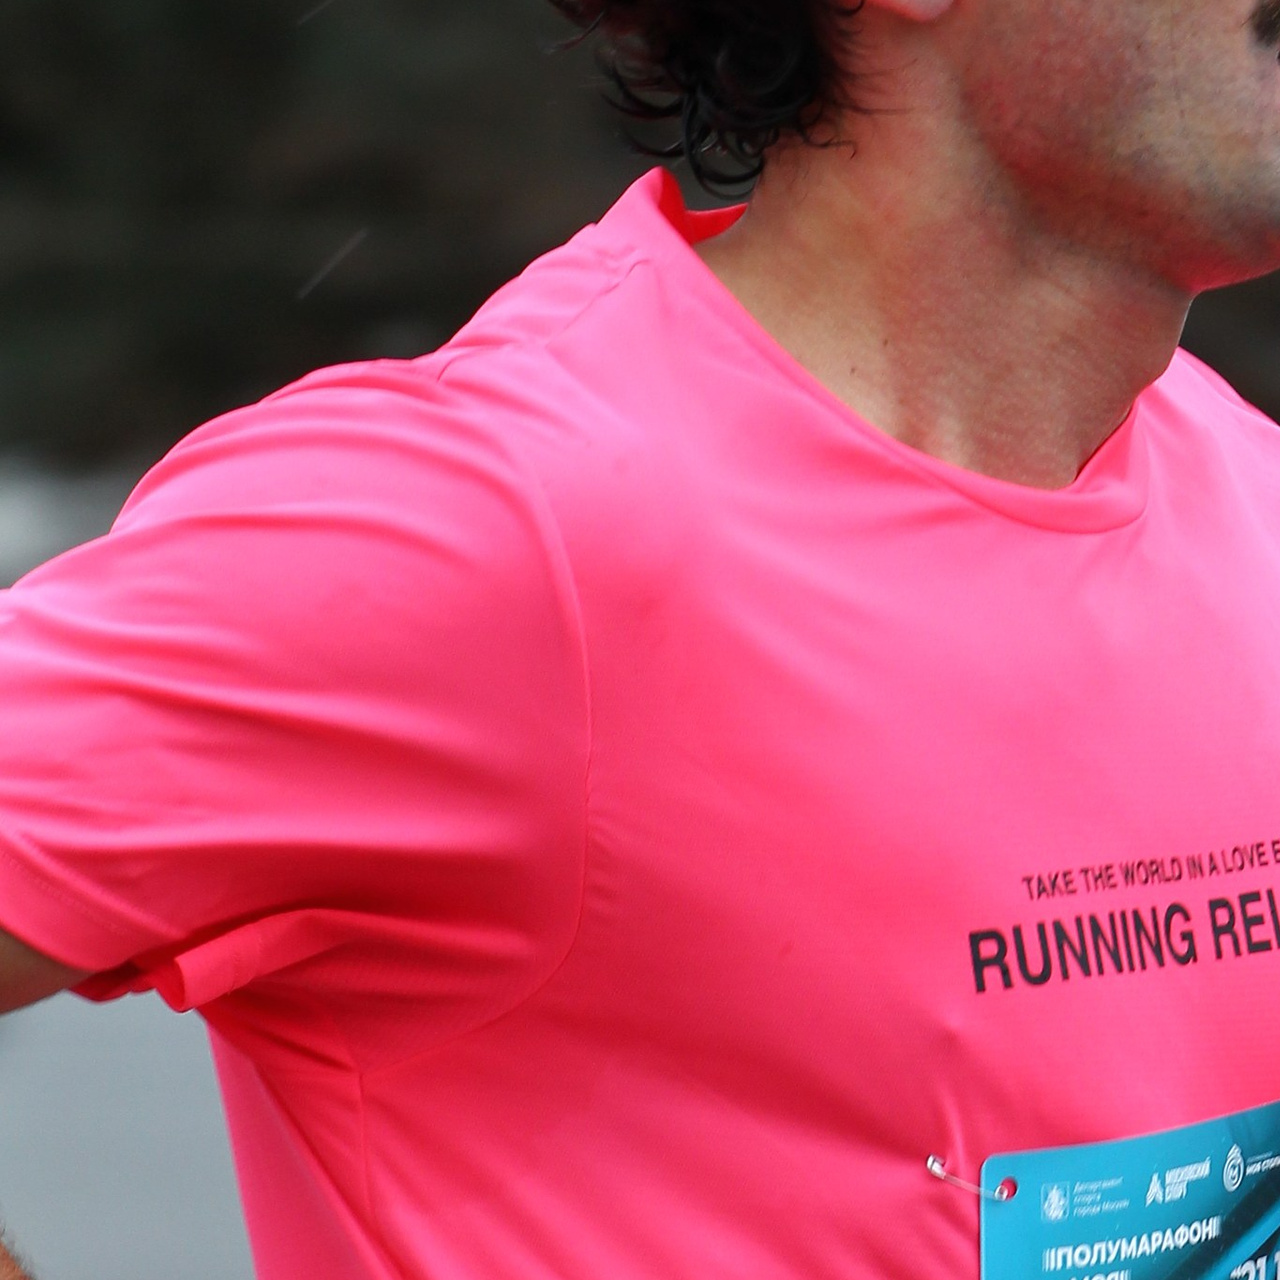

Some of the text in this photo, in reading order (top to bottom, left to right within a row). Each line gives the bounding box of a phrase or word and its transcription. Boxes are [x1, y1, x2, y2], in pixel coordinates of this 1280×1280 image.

[1021, 870, 1077, 900] TAKE
[1080, 863, 1118, 892] THE
[1119, 856, 1183, 887] WORLD
[1186, 852, 1204, 881] IN
[1208, 851, 1220, 877] A
[1221, 841, 1268, 875] LOVE
[968, 901, 1198, 994] RUNNING
[1056, 1216, 1216, 1270] ПОЛУМАРАФОН
